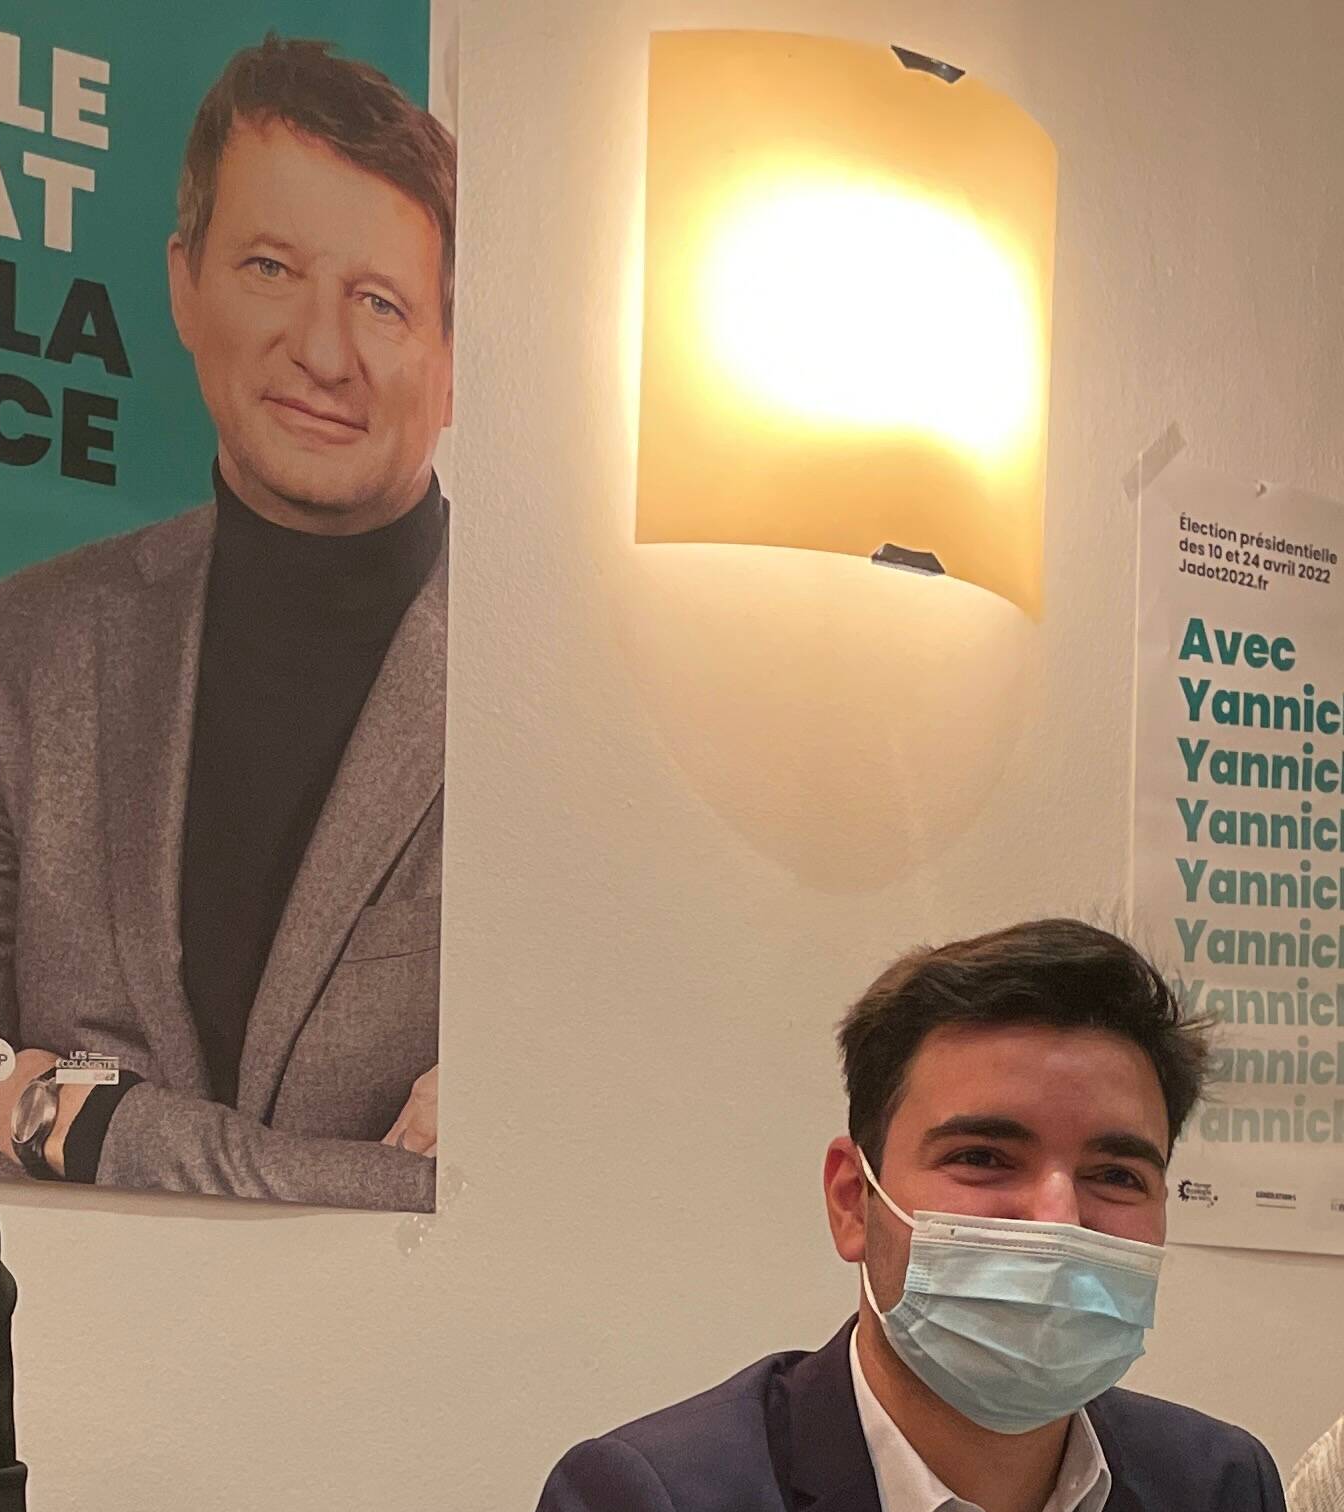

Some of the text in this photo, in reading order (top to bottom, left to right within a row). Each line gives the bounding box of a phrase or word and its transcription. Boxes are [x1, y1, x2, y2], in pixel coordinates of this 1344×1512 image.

[1179, 512, 1338, 564] Élection présidentielle
[1179, 538, 1331, 584] des 10 et 24 avril 2022
[1179, 559, 1269, 591] Jadot2022.fr
[1178, 617, 1296, 671] Avec
